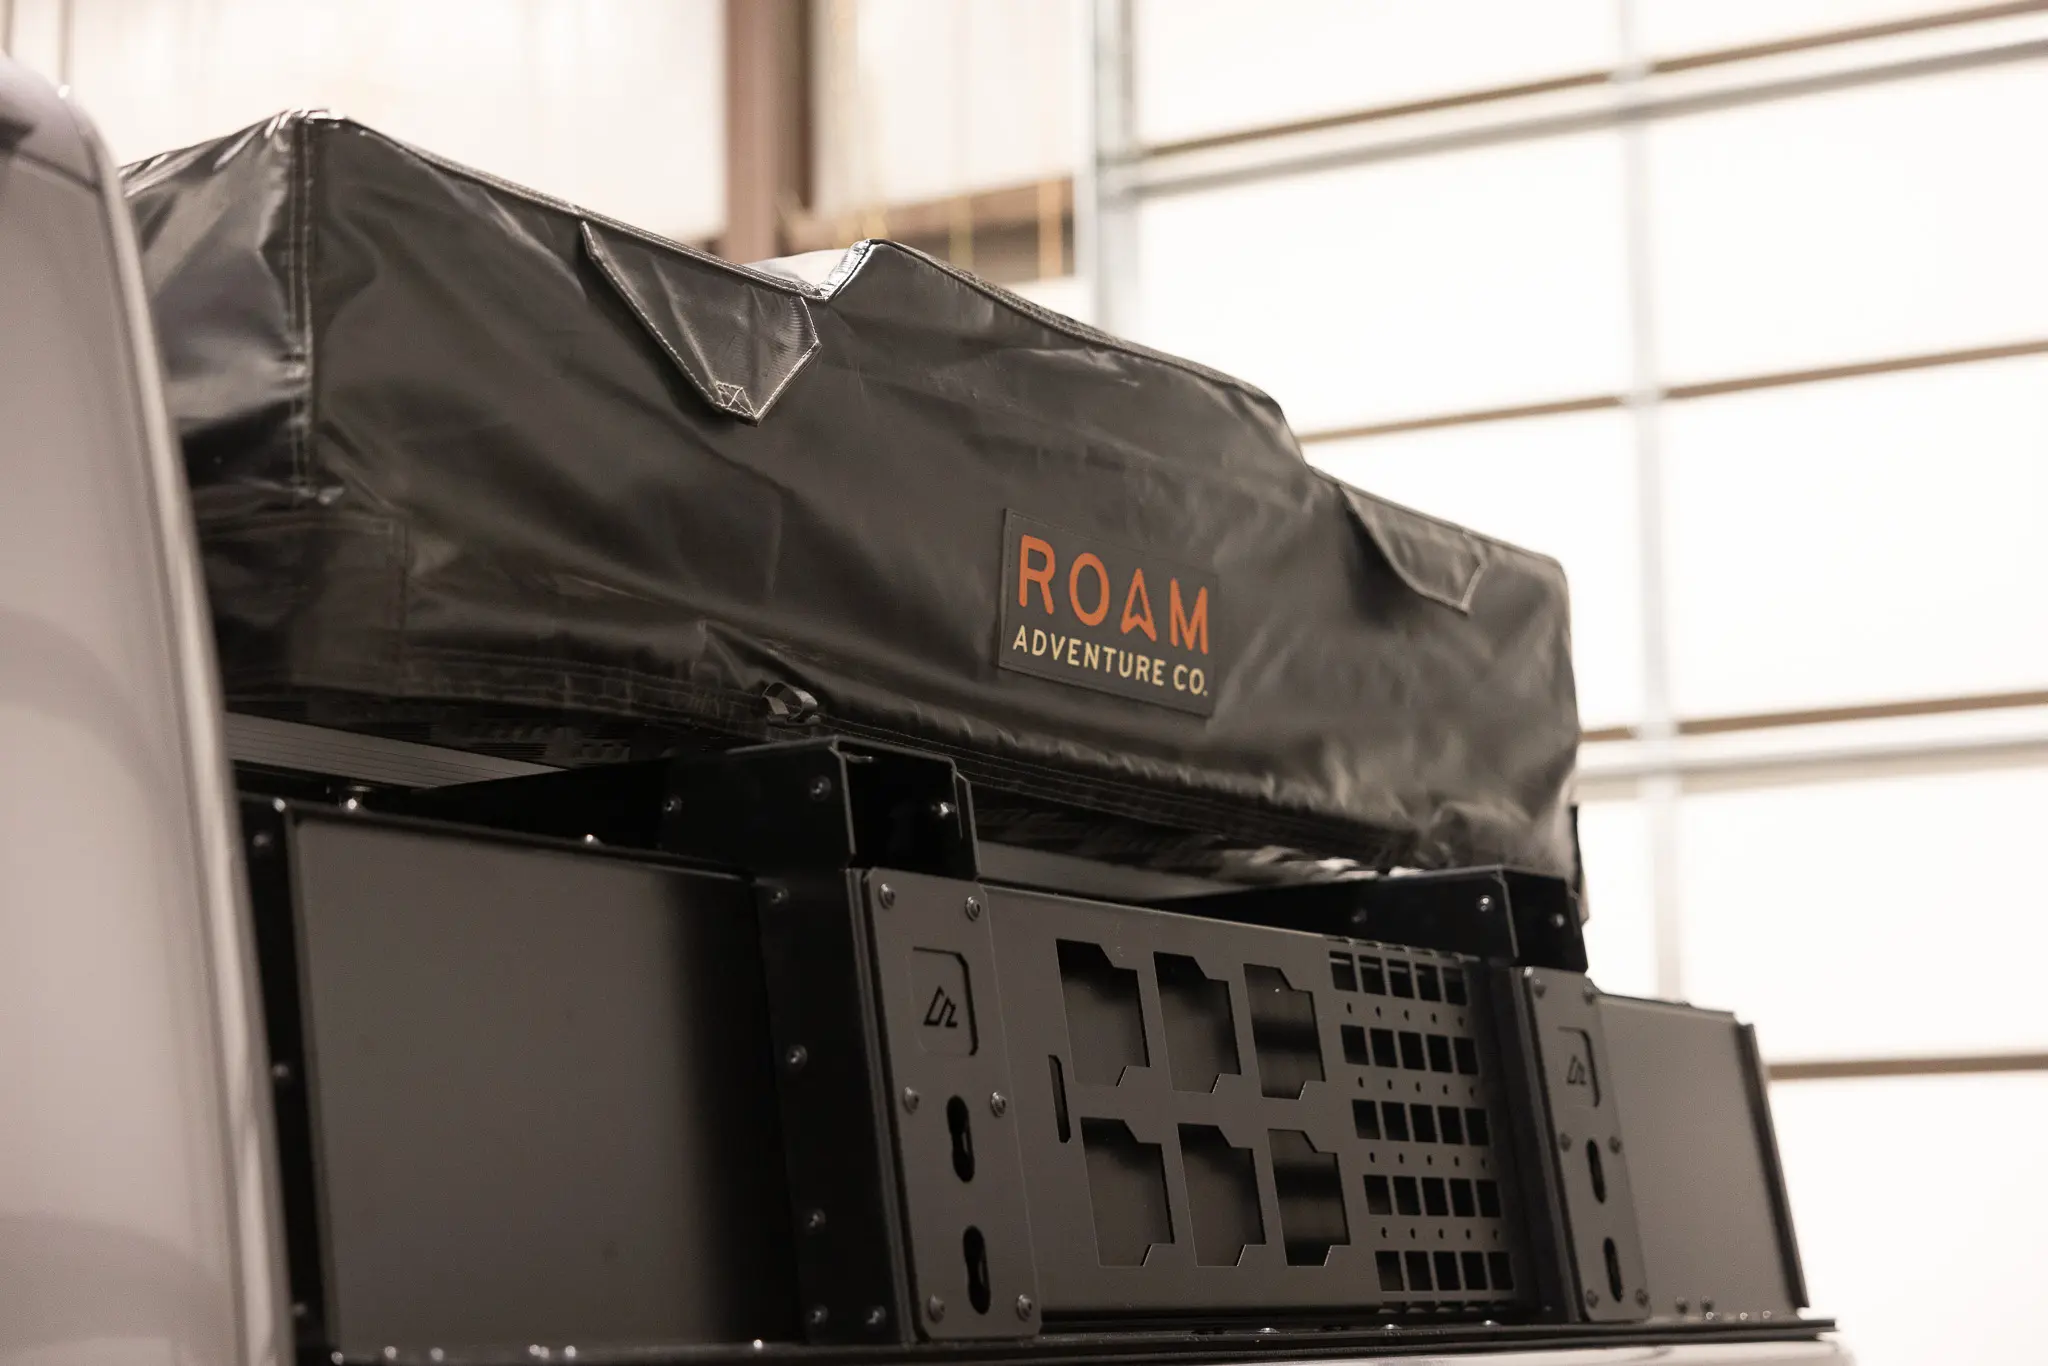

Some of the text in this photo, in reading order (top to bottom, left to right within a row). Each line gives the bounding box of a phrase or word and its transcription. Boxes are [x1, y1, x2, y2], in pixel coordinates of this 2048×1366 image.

[1018, 534, 1208, 655] ROAM
[1012, 624, 1208, 697] ADVENTURE CO.
